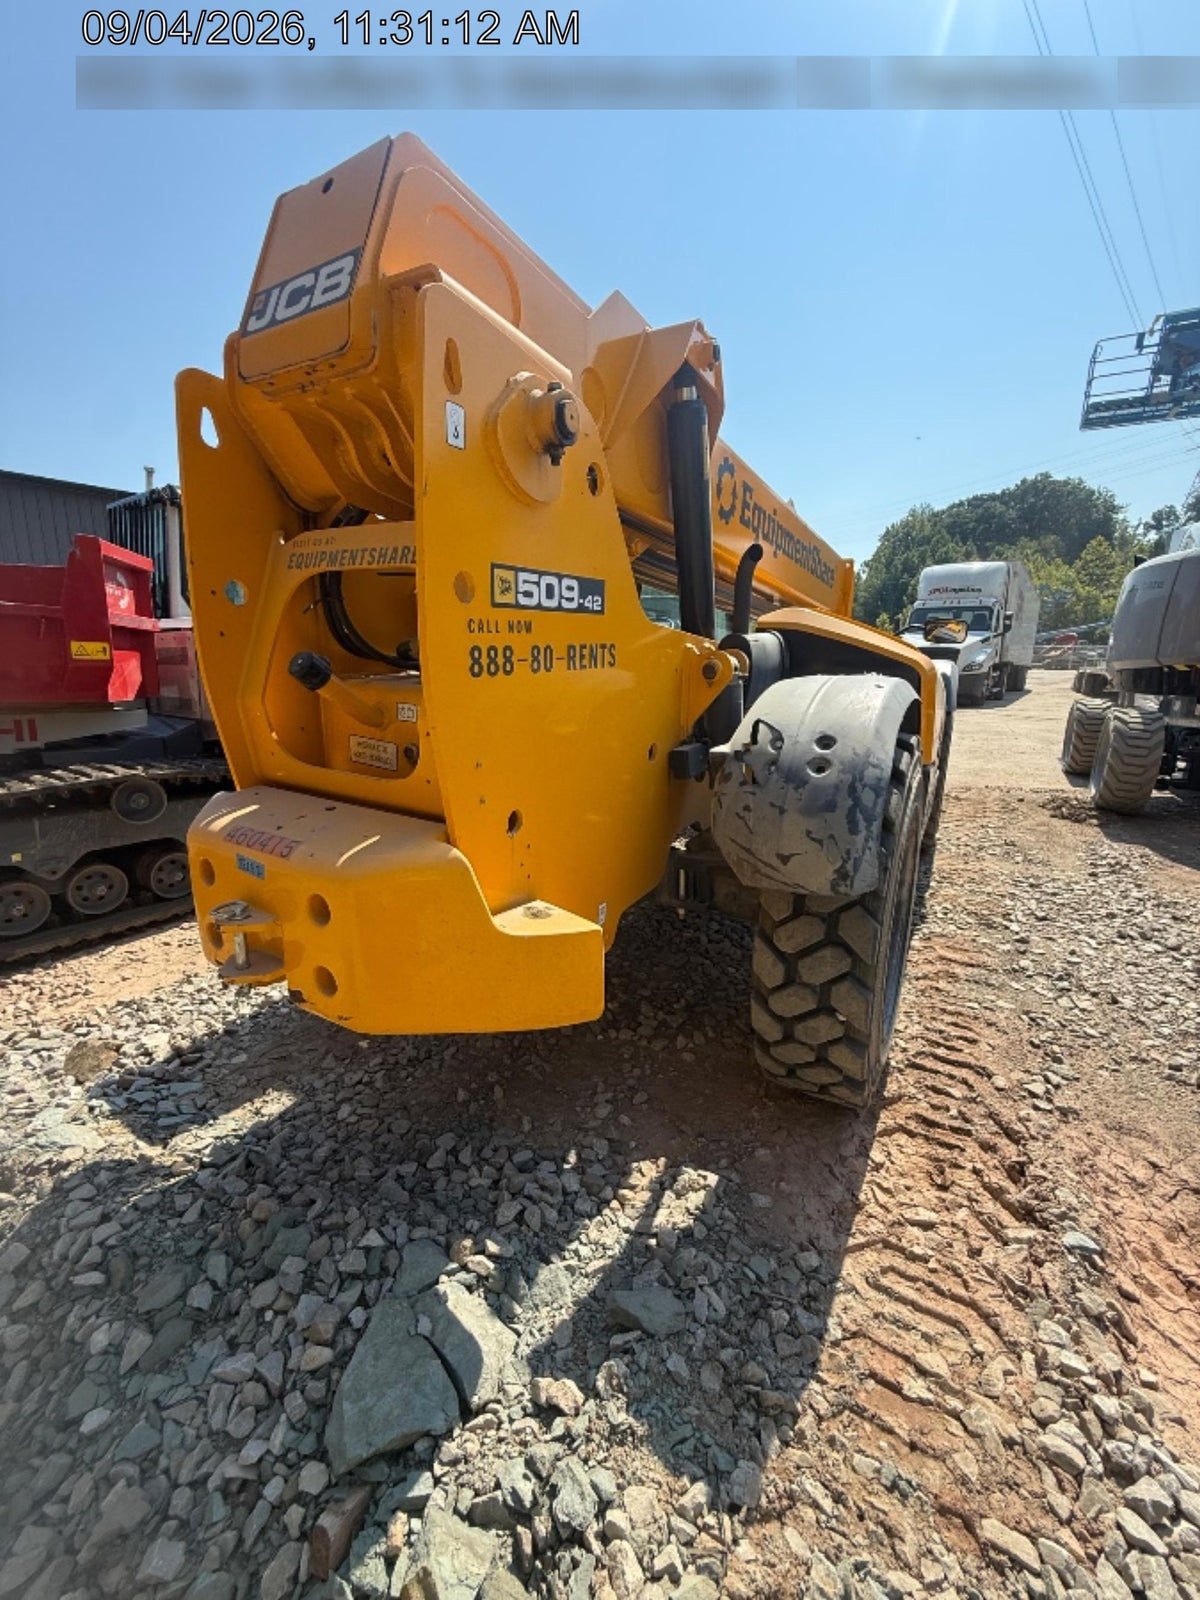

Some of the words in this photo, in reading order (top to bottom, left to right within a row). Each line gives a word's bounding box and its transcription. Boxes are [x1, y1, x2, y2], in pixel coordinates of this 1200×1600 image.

[246, 255, 355, 332] JCB
[739, 479, 835, 589] EquipmentShare
[516, 571, 602, 611] 509-42
[468, 618, 501, 634] CALL
[508, 619, 533, 634] NOW
[469, 643, 616, 678] 888-80-RENTS
